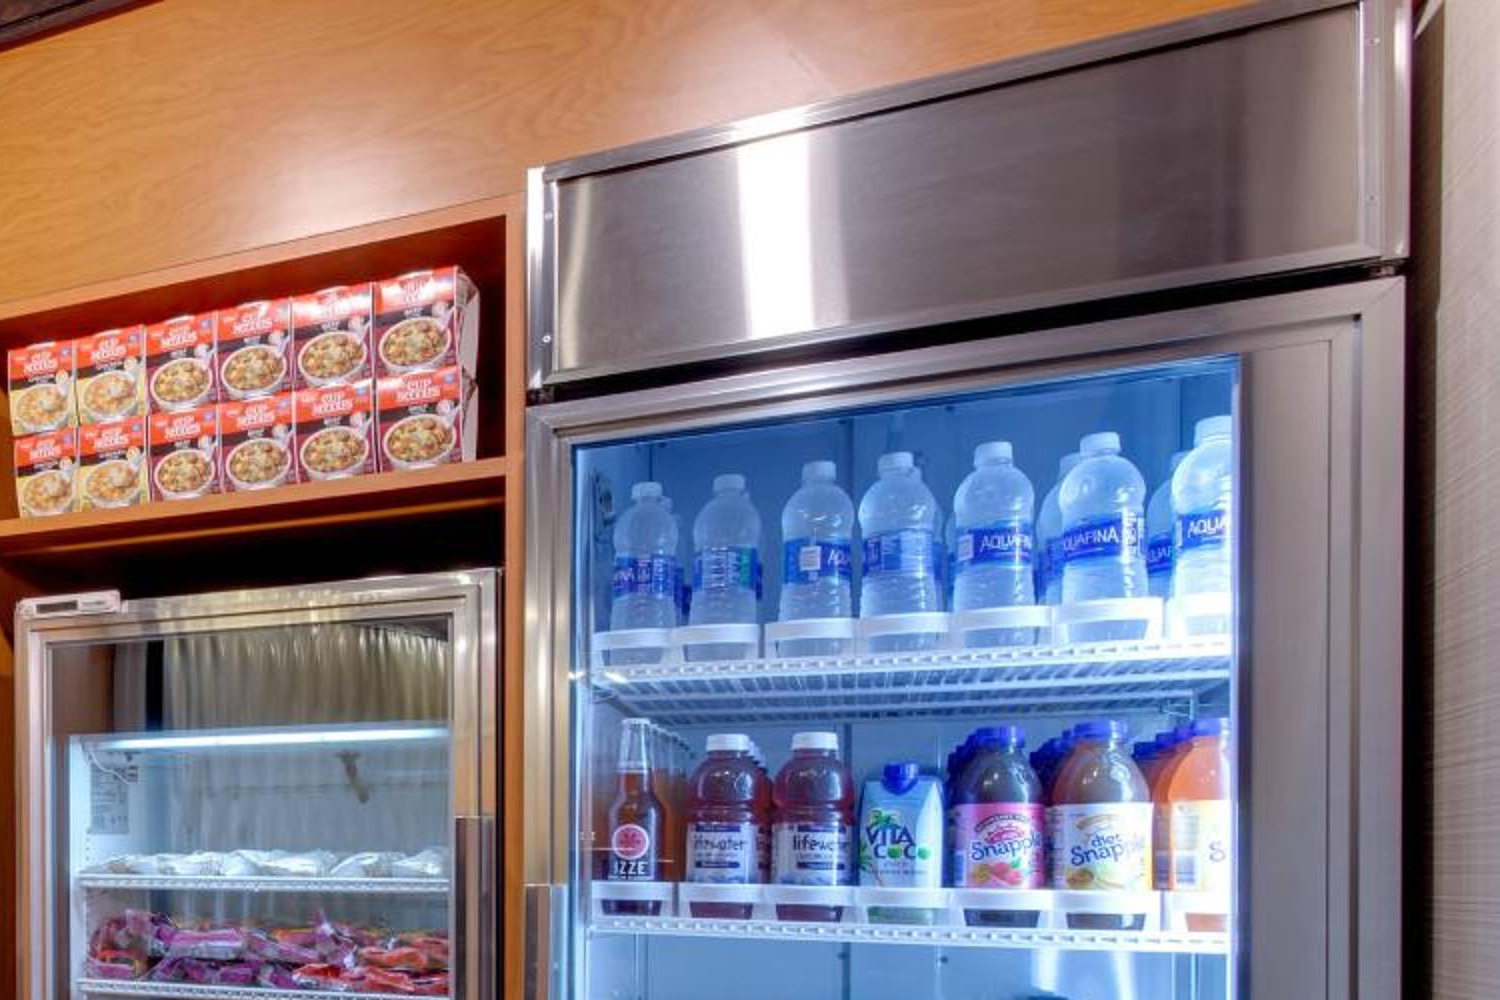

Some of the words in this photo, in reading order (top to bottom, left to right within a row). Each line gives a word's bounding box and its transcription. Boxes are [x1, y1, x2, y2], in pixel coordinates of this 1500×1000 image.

[980, 534, 1032, 551] AQUAFIN
[866, 826, 915, 846] VITA
[1091, 832, 1122, 849] diet
[971, 832, 1043, 863] Snapple
[614, 861, 647, 876] IZZE
